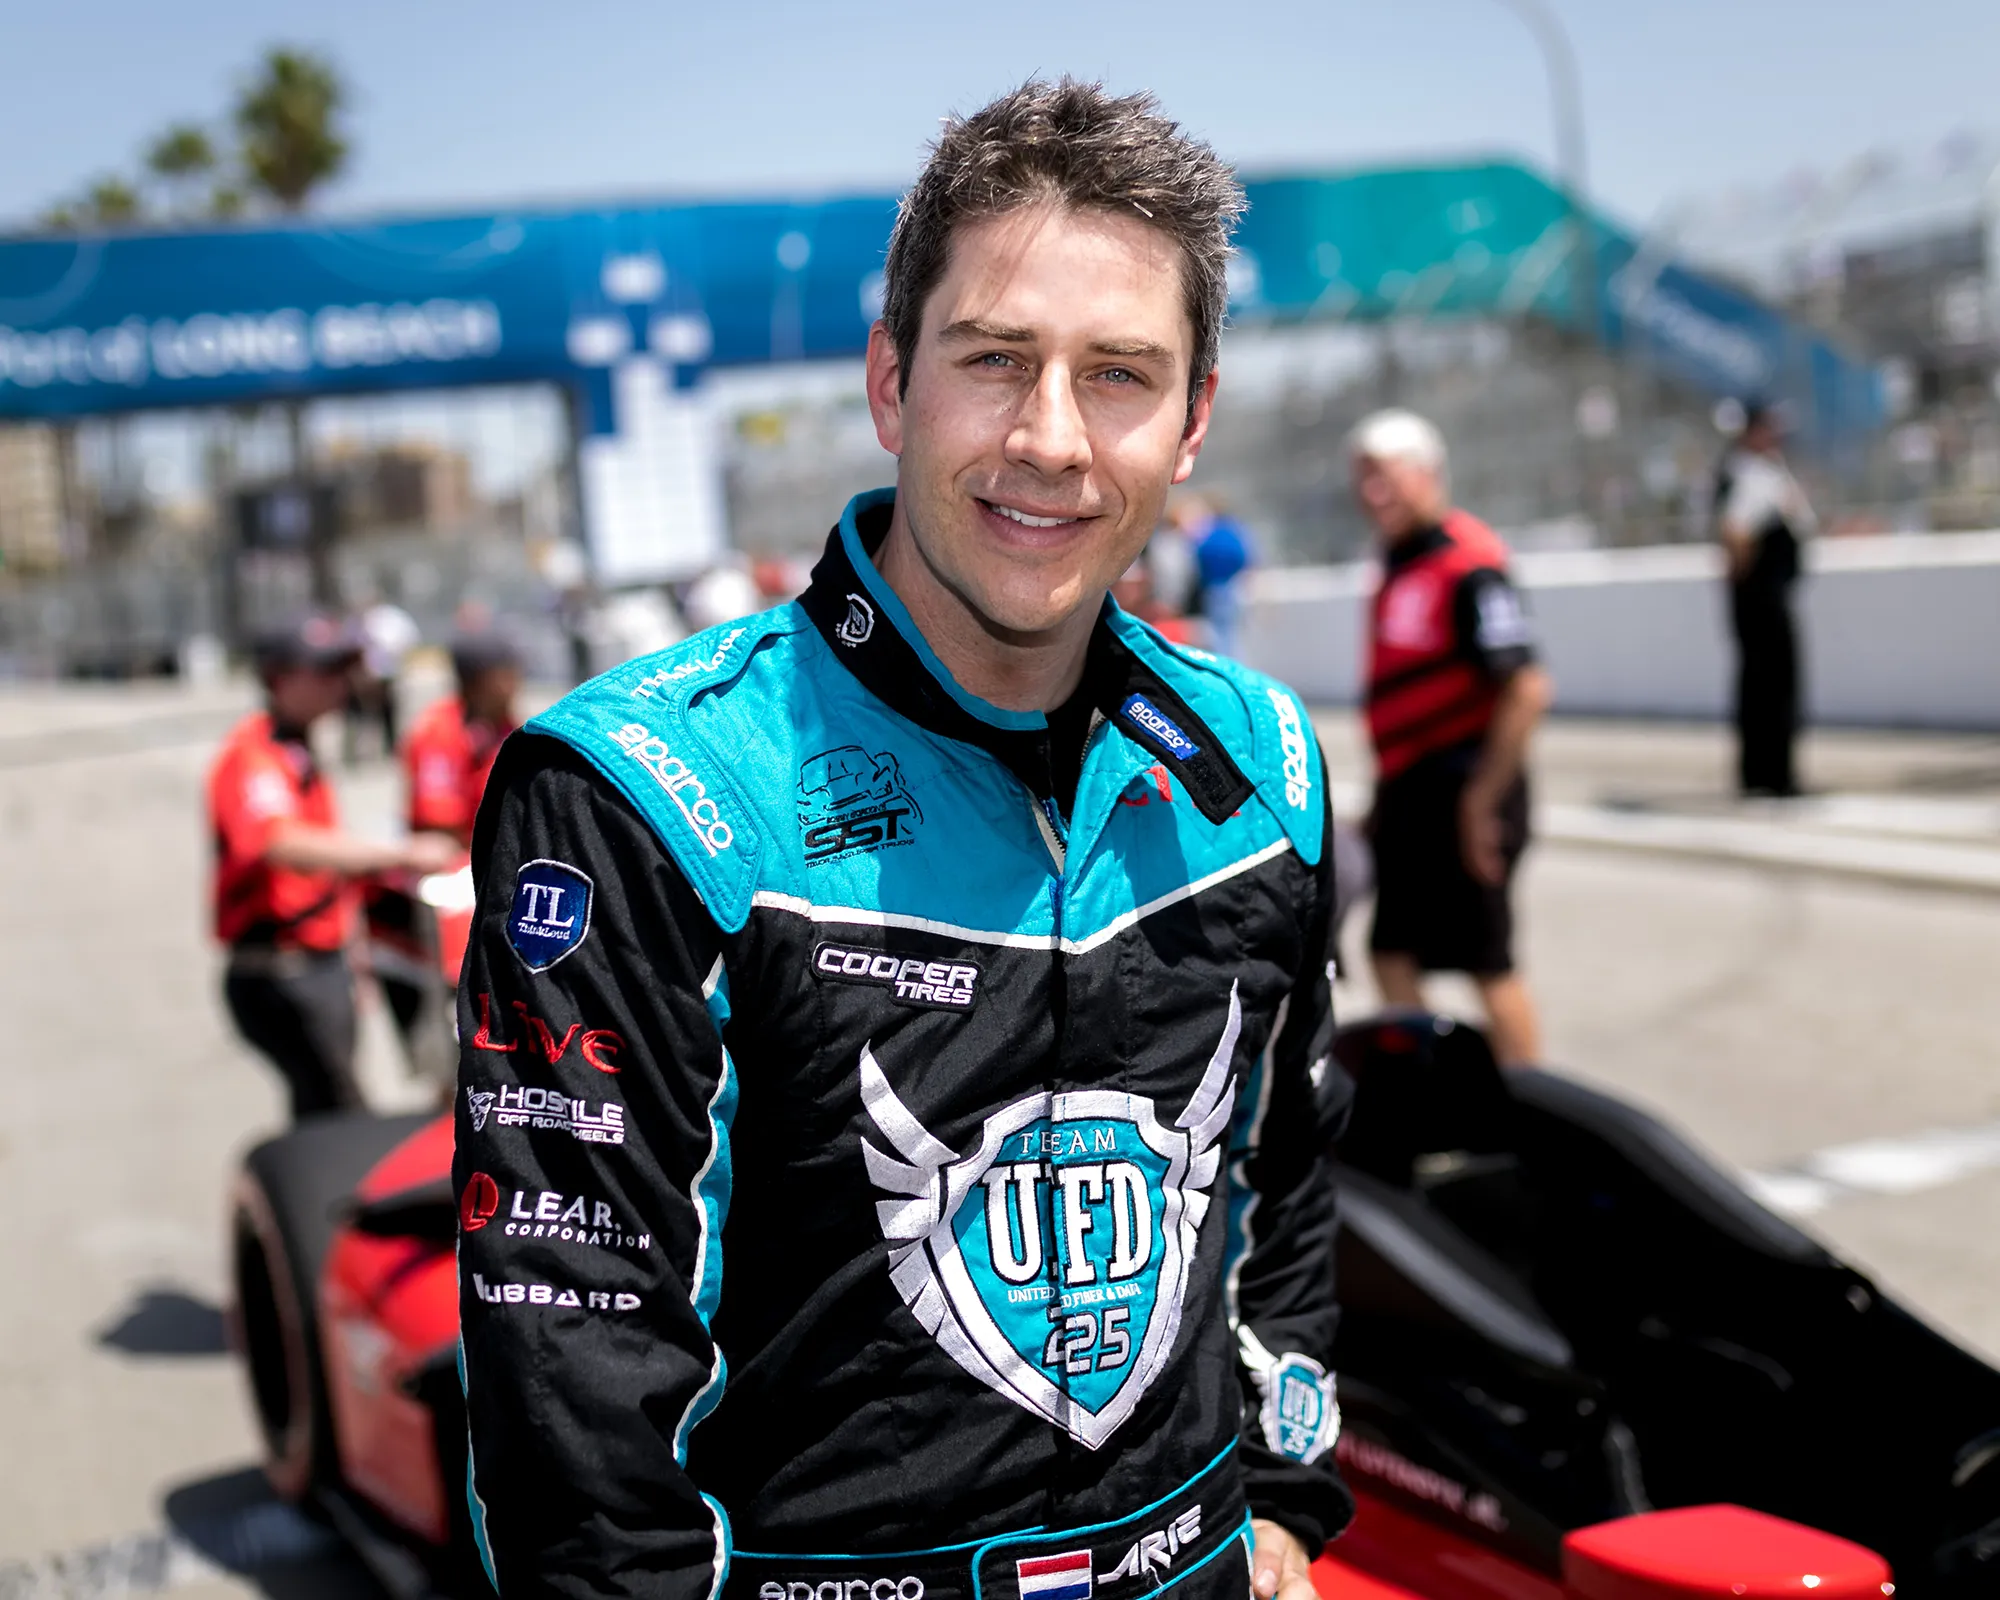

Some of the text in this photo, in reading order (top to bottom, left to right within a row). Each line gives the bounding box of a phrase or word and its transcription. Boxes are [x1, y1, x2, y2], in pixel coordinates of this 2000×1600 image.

[151, 307, 312, 380] LONG
[607, 723, 734, 858] sparco
[804, 808, 910, 860] SST
[521, 883, 575, 927] TL
[817, 948, 978, 989] COOPER
[895, 980, 973, 1005] TIRES
[497, 1113, 530, 1126] OFF
[505, 1222, 650, 1249] CORPORATION
[980, 1159, 1153, 1288] UFD
[1097, 1504, 1202, 1585] ARIE
